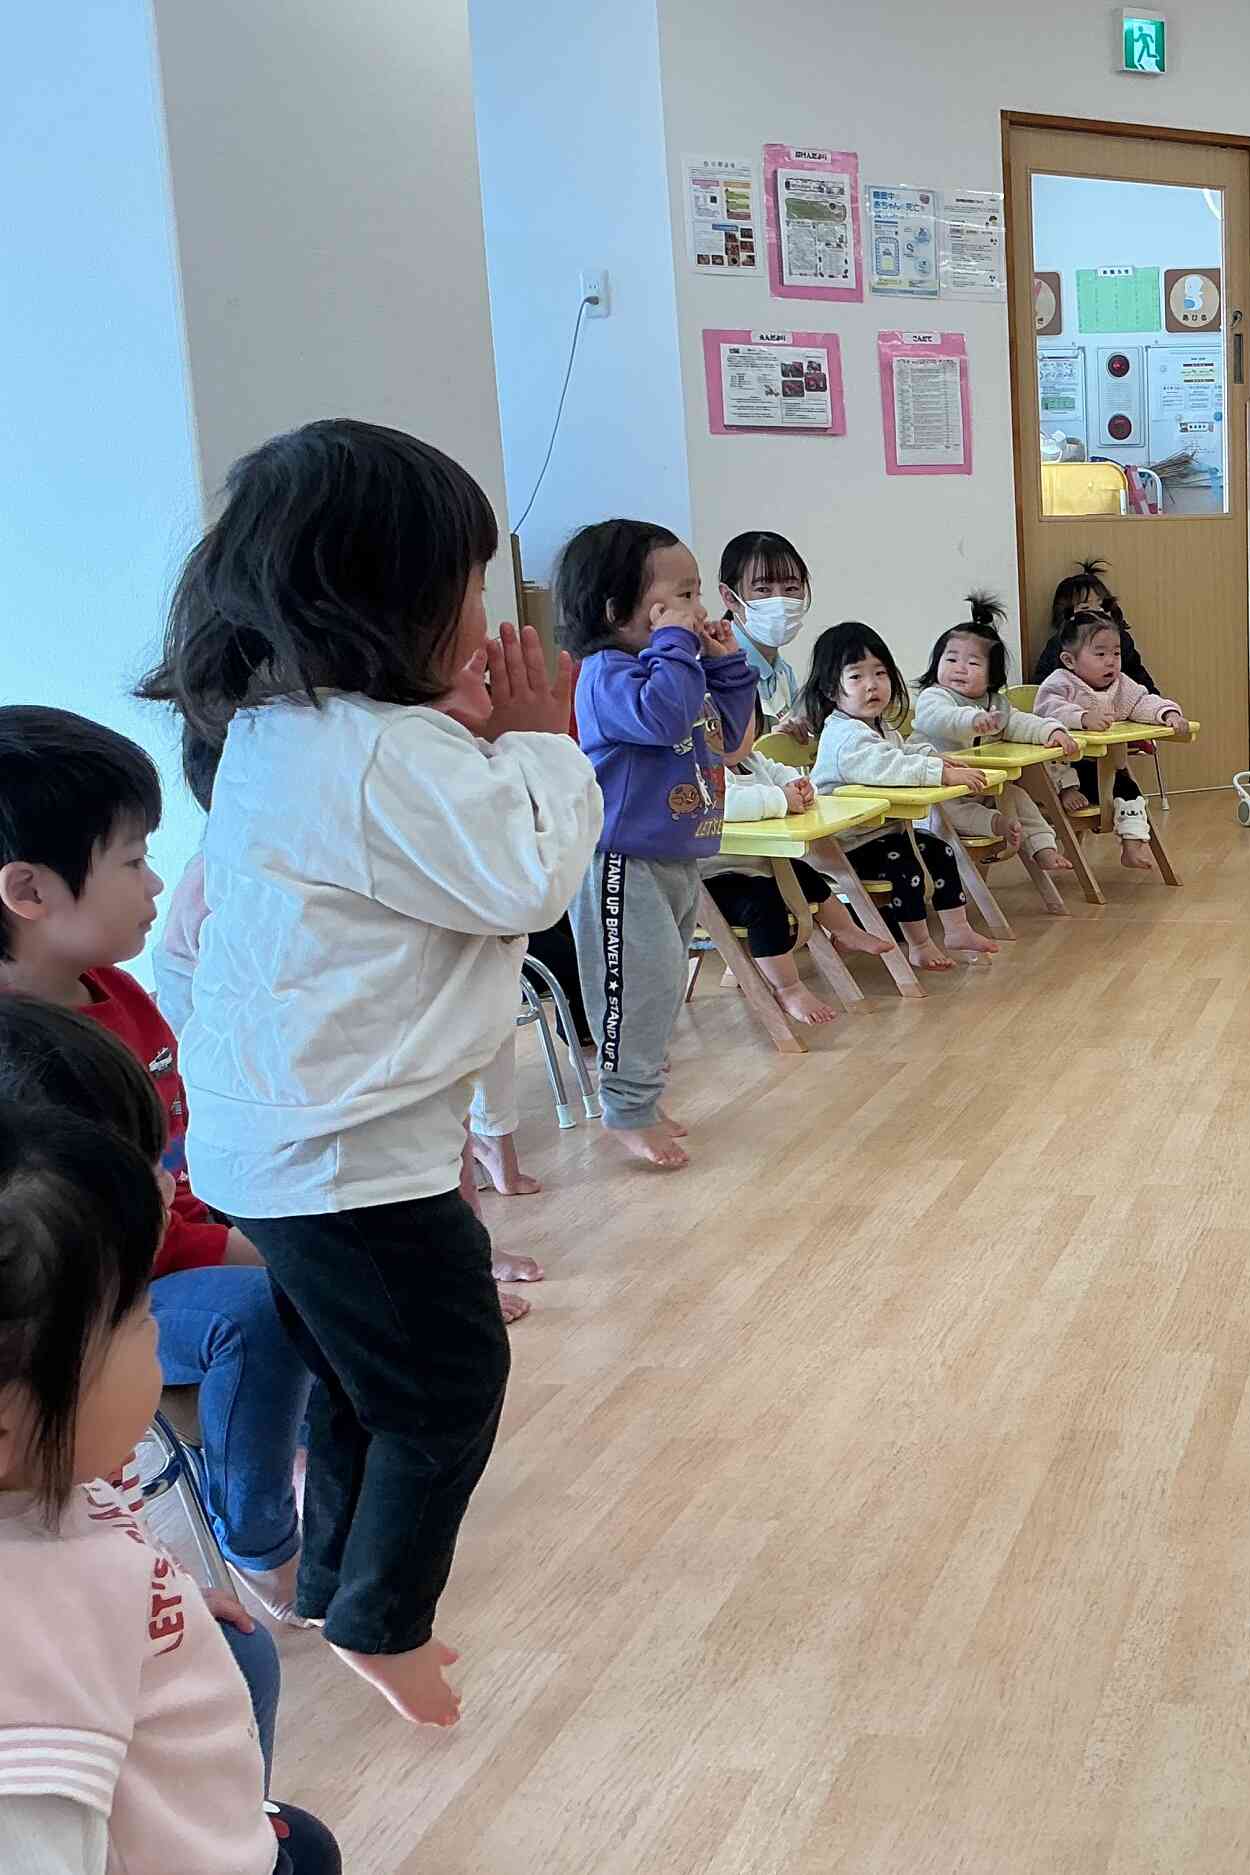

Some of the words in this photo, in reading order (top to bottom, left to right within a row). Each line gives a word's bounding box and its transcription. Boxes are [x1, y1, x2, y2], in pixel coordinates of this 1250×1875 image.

[606, 897, 619, 915] UP
[606, 918, 620, 977] BRAVELY
[606, 996, 620, 1039] STAND
[605, 1042, 615, 1060] UP
